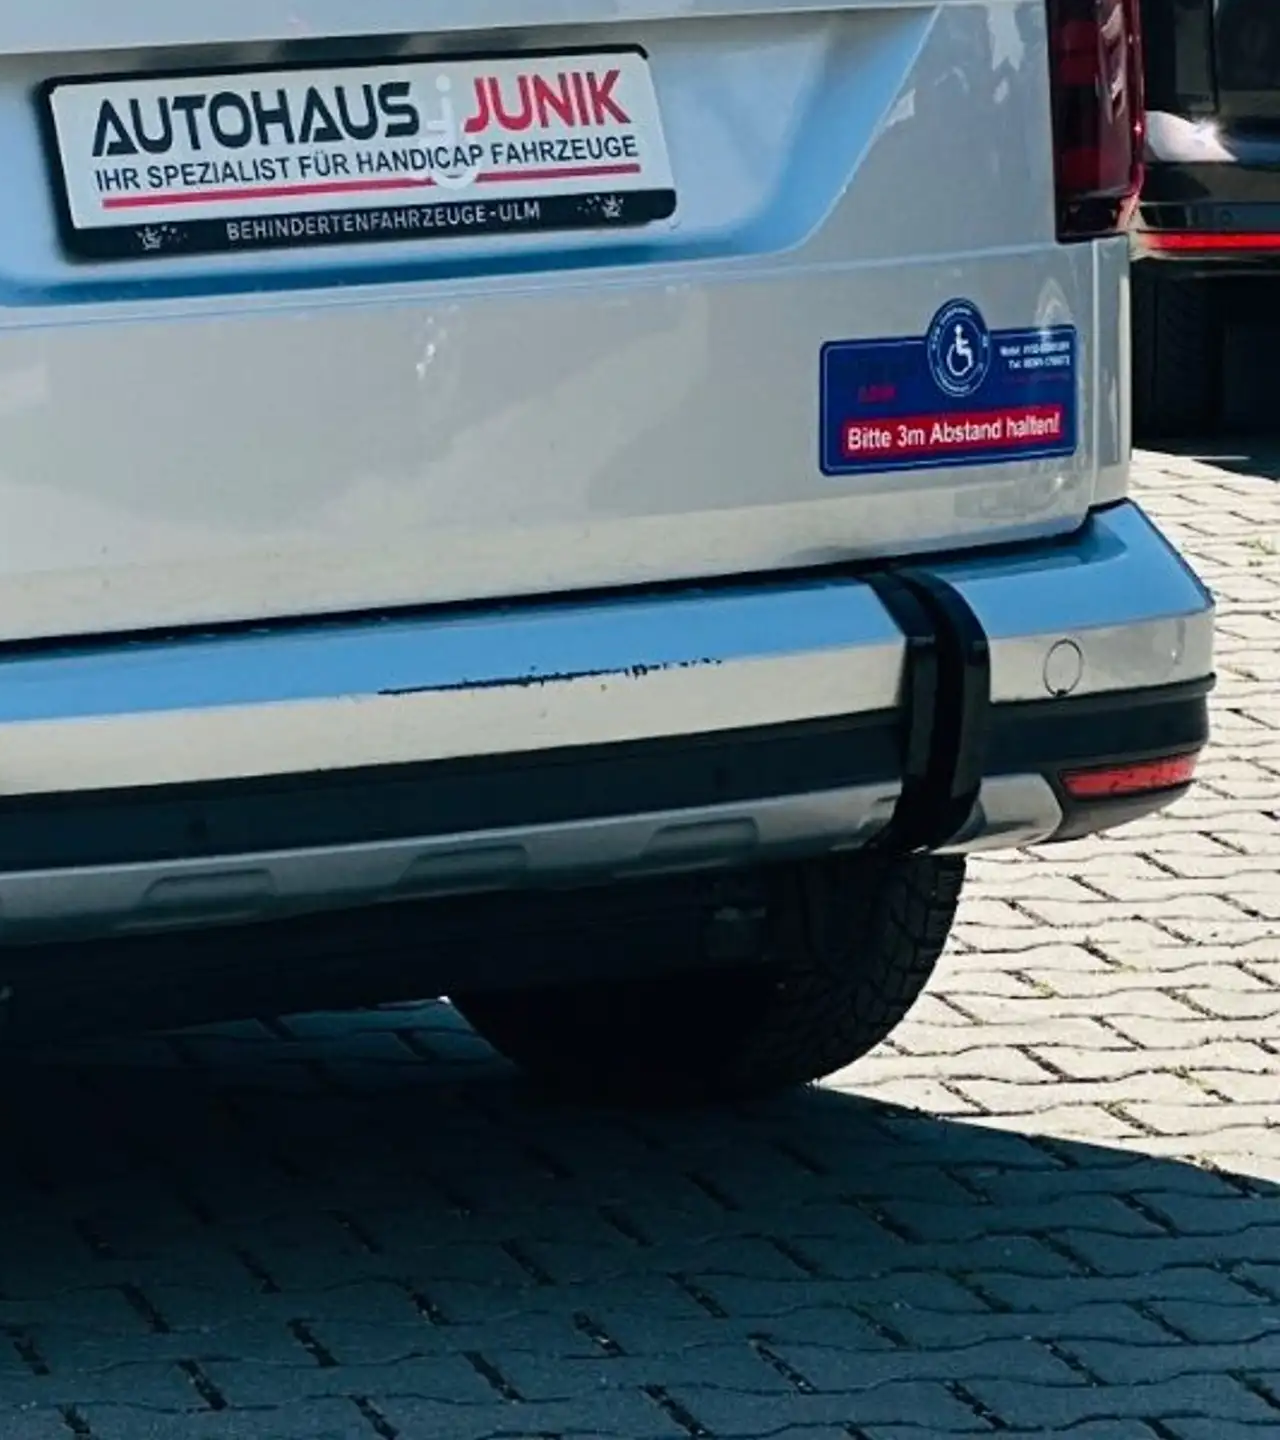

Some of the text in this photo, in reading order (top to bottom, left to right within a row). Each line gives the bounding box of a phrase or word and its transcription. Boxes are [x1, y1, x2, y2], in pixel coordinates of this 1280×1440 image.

[92, 69, 632, 157] AUTOHAUS JUNIK
[95, 134, 639, 191] IHR SPEZIALIST FÜR HANDICAP FAHRZEUGE
[226, 200, 540, 241] BEHINDERTENFAHRZEUGE-ULM
[847, 411, 1061, 451] Bitte 3m Abstand halten!
